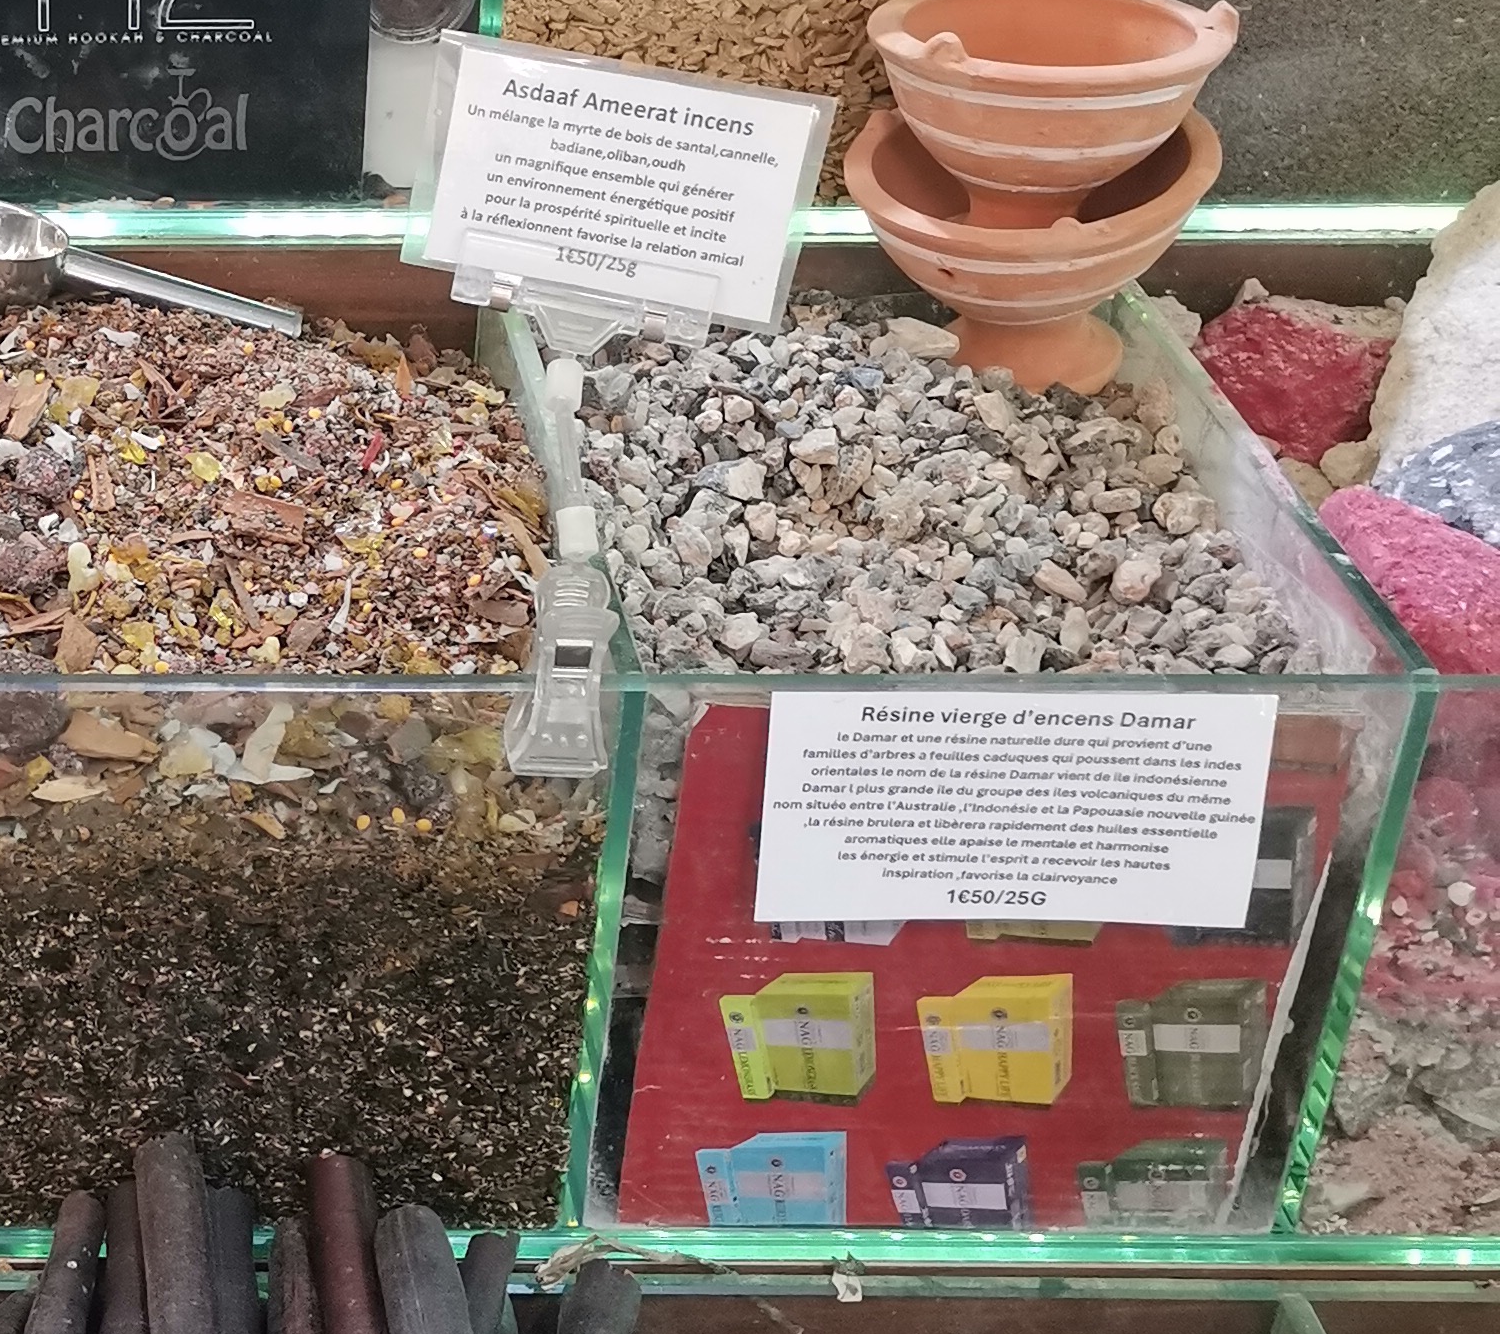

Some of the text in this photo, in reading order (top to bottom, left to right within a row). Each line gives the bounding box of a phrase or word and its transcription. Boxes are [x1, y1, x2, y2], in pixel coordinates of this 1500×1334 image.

[68, 31, 145, 46] HOOKAH
[154, 31, 165, 44] &
[176, 30, 274, 44] CHARCOAL
[502, 79, 754, 136] Asdaaf Ameerat incens
[5, 94, 250, 159] Charcoal
[494, 153, 735, 202] un magnifique ensemble qui générer
[555, 245, 638, 279] 1€50/25g
[861, 705, 1196, 730] Résine vierge d’encens Damar
[947, 889, 1047, 906] 1€50/25G
